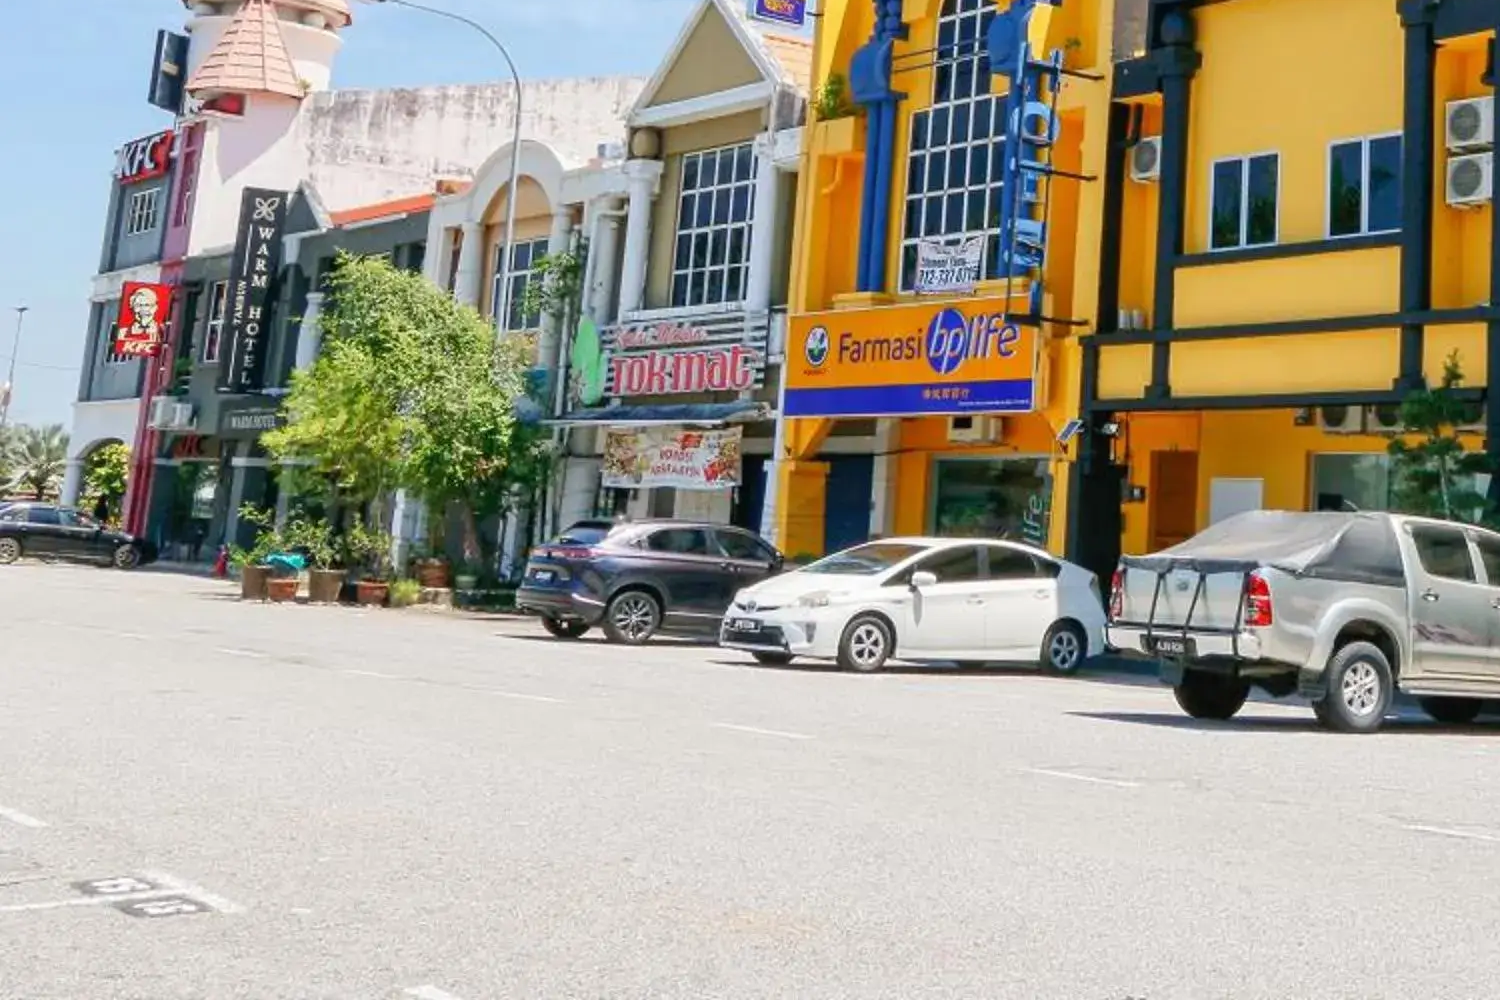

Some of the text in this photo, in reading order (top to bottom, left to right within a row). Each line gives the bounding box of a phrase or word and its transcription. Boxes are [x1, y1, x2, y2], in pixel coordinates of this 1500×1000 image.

[116, 133, 166, 179] KFC
[241, 227, 275, 385] WARM HOTEL
[122, 341, 156, 354] KFC
[838, 329, 922, 364] Farmasi
